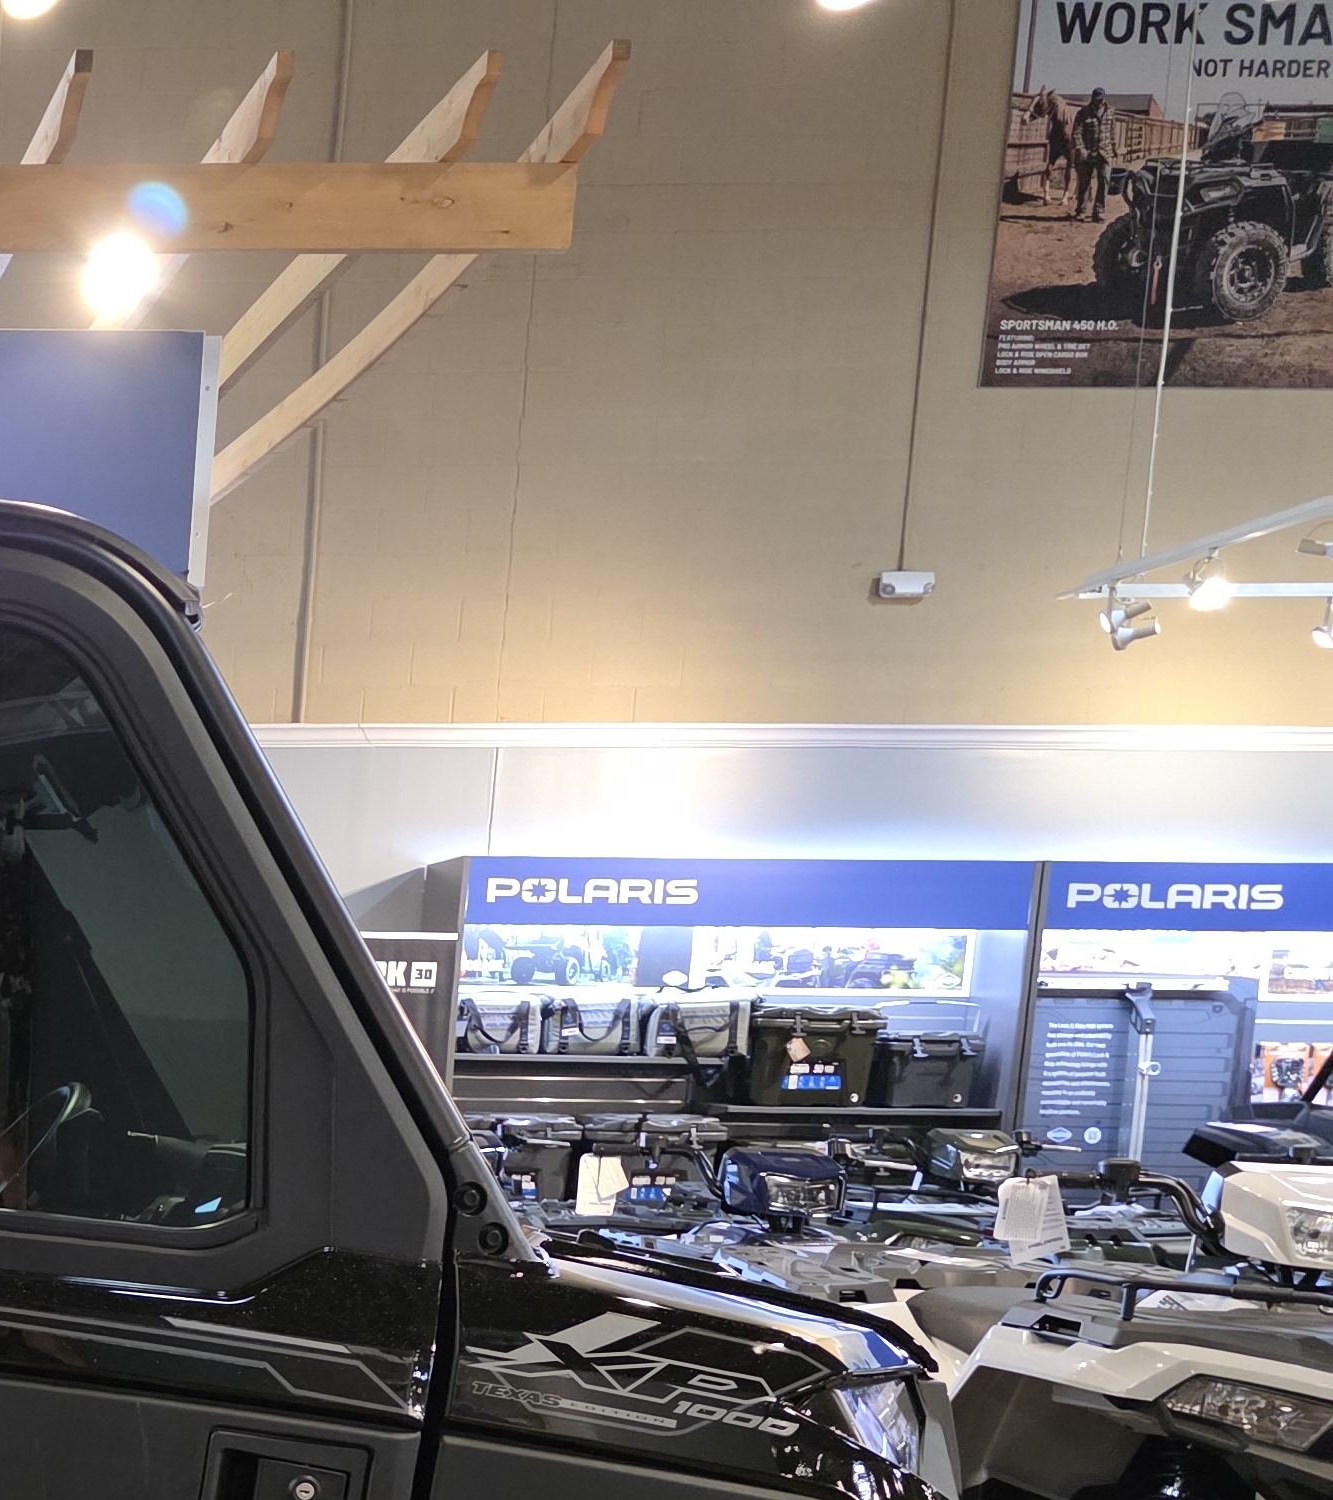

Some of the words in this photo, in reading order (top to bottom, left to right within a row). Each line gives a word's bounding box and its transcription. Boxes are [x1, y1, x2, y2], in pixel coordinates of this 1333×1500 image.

[1056, 1, 1206, 45] WORK
[1223, 2, 1333, 46] SMA
[1193, 58, 1233, 78] NOT
[1238, 58, 1331, 79] HARDER
[1000, 319, 1070, 331] SPORTSMAN
[1073, 320, 1095, 331] 450
[1097, 320, 1119, 331] H.O.
[485, 877, 700, 905] POLARIS
[1066, 882, 1284, 910] POLARIS
[466, 1311, 777, 1405] XP
[472, 1381, 563, 1408] TEXAS
[671, 1400, 801, 1437] 1000
